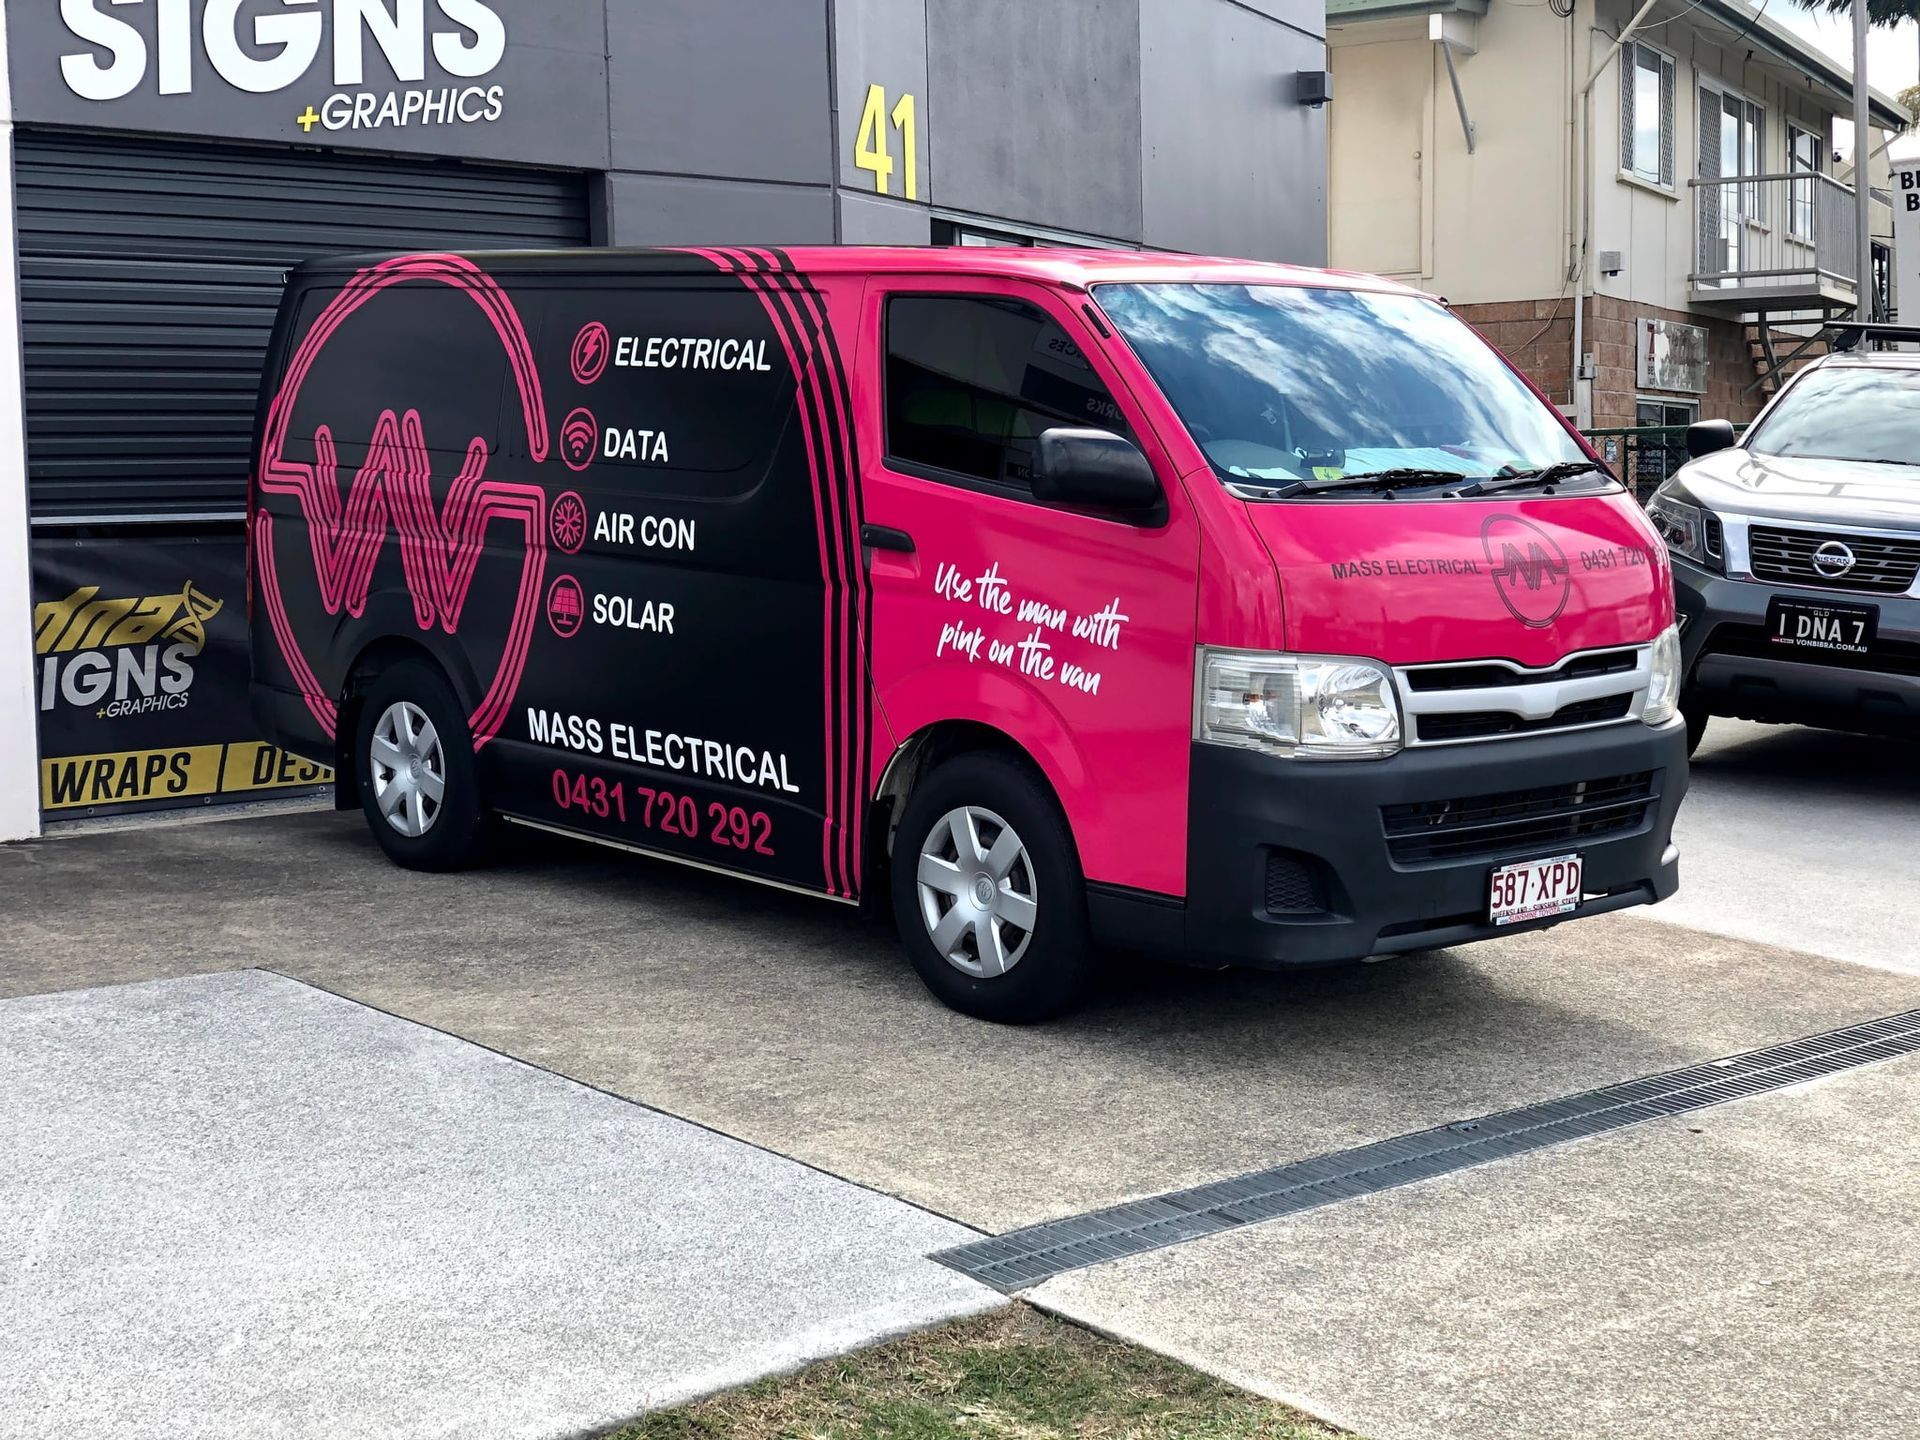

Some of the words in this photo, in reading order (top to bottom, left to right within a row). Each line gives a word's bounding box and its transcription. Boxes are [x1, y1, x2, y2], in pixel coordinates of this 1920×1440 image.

[60, 0, 506, 100] SIGNS
[854, 83, 917, 201] 41
[614, 336, 772, 371] ELECTRICAL
[603, 427, 669, 463] DATA
[594, 511, 634, 544] AIR
[640, 516, 696, 551] CON
[1331, 561, 1383, 580] MASS
[1389, 558, 1482, 577] ELECTRICAL
[1580, 548, 1617, 570] 0431
[1617, 545, 1646, 566] 720
[1813, 554, 1850, 566] NISSAN
[592, 593, 675, 634] SOLAR
[933, 561, 973, 602] Use
[975, 561, 1013, 615] the
[1016, 598, 1067, 632] man
[1072, 597, 1130, 650] with
[1796, 615, 1842, 642] DNA
[1852, 620, 1865, 644] 7
[936, 619, 986, 663] pink
[988, 638, 1015, 668] on
[1017, 625, 1055, 681] the
[1059, 662, 1101, 696] van
[1796, 638, 1868, 653] VONBIBRA.COM.AU
[40, 642, 199, 711] IGNS
[51, 752, 191, 805] WRAPS
[252, 745, 331, 785] DES
[527, 707, 603, 753] MASS
[610, 723, 800, 793] ELECTRICAL
[552, 769, 626, 823] 0431
[637, 787, 698, 838] 720
[708, 802, 775, 856] 292
